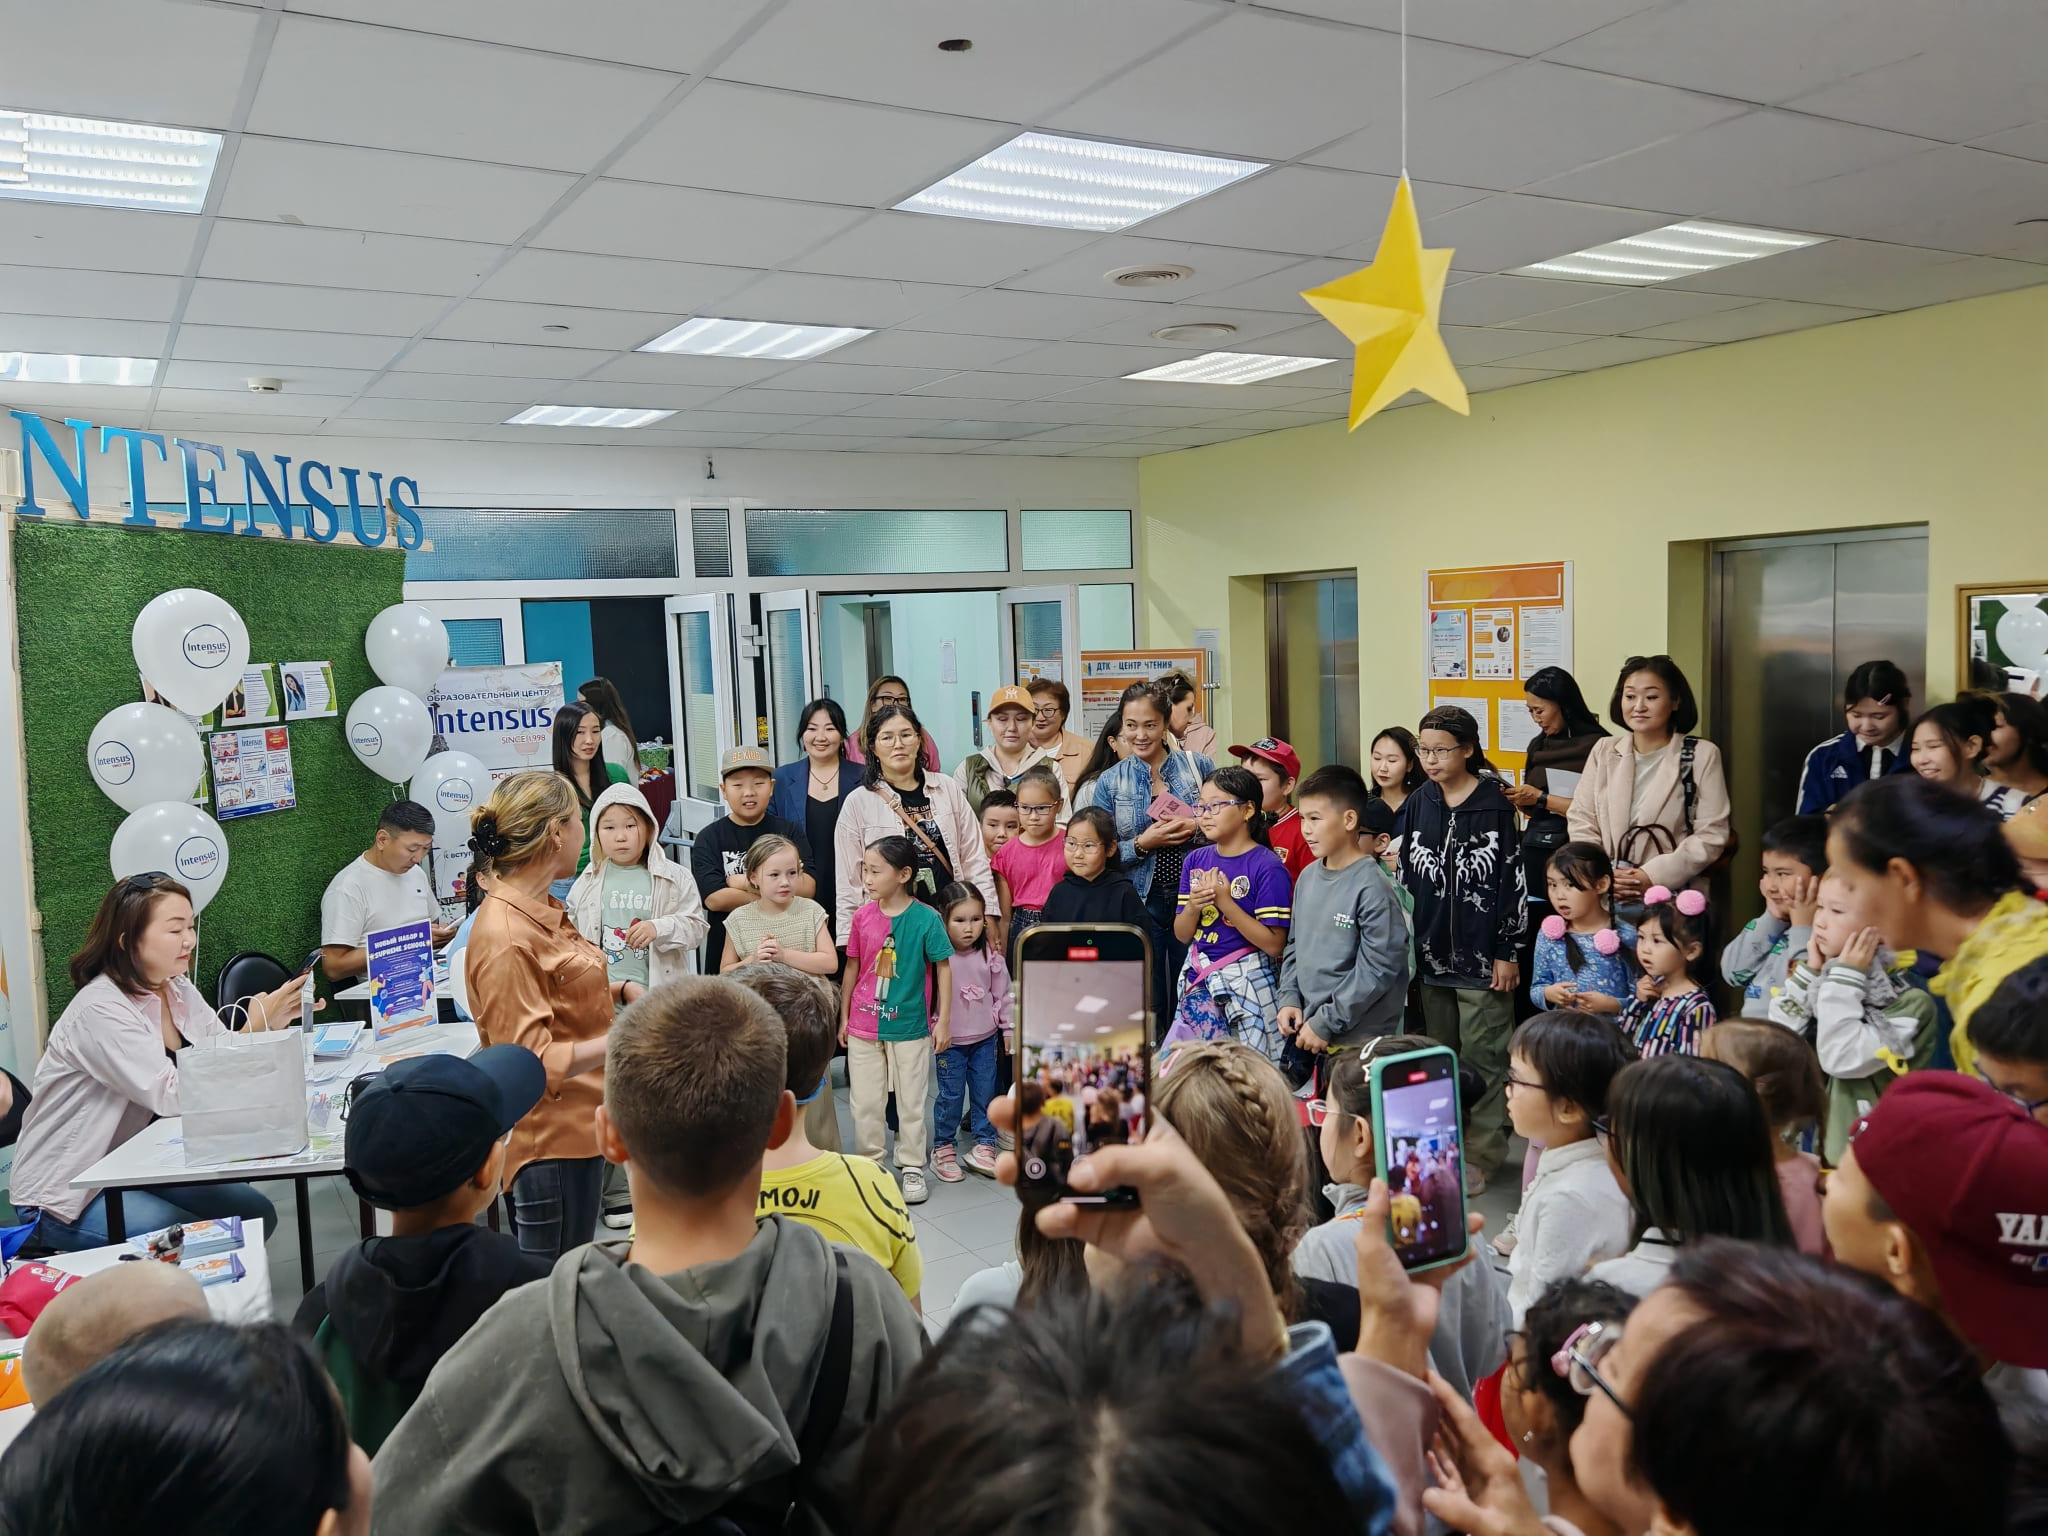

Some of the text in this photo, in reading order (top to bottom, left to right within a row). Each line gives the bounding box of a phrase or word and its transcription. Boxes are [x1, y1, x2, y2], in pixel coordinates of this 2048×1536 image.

[9, 410, 424, 550] NTENSUS
[187, 642, 227, 652] Intensus
[1096, 662, 1111, 671] ДТК
[1119, 661, 1142, 671] ЦЕНТР
[1144, 660, 1173, 670] ЧТЕНИЯ
[427, 689, 550, 702] ОБРАЗОВАТЕЛЬНЫЙ ЦЕНТР
[501, 734, 547, 744] SINCE 1998
[97, 755, 131, 766] Intensus
[440, 790, 470, 799] Intensus
[180, 850, 216, 867] Intensus
[374, 936, 397, 949] НОВЫЙ
[397, 932, 418, 942] НАБОР
[374, 945, 402, 958] SUPREME
[403, 940, 426, 951] SCHOOL
[760, 1186, 821, 1210] MOJI
